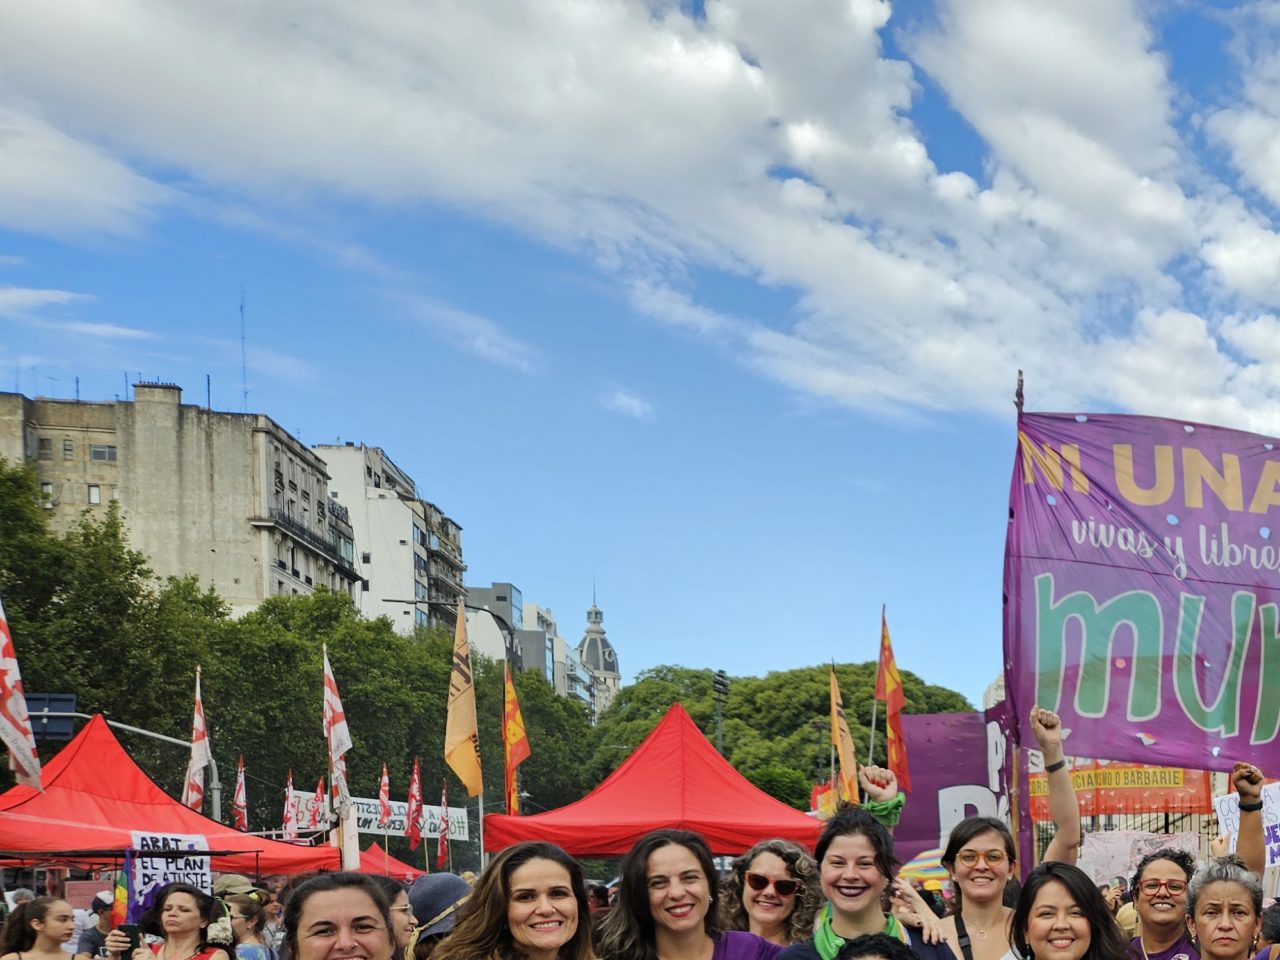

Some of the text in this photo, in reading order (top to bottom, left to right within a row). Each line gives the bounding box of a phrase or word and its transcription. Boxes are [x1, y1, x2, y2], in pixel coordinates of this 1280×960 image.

[1018, 431, 1090, 496] NI
[1071, 515, 1156, 559] vivas
[1164, 530, 1189, 581] y
[1123, 769, 1181, 786] BARBARIE
[141, 857, 205, 871] EL PLAN
[141, 872, 158, 886] DE
